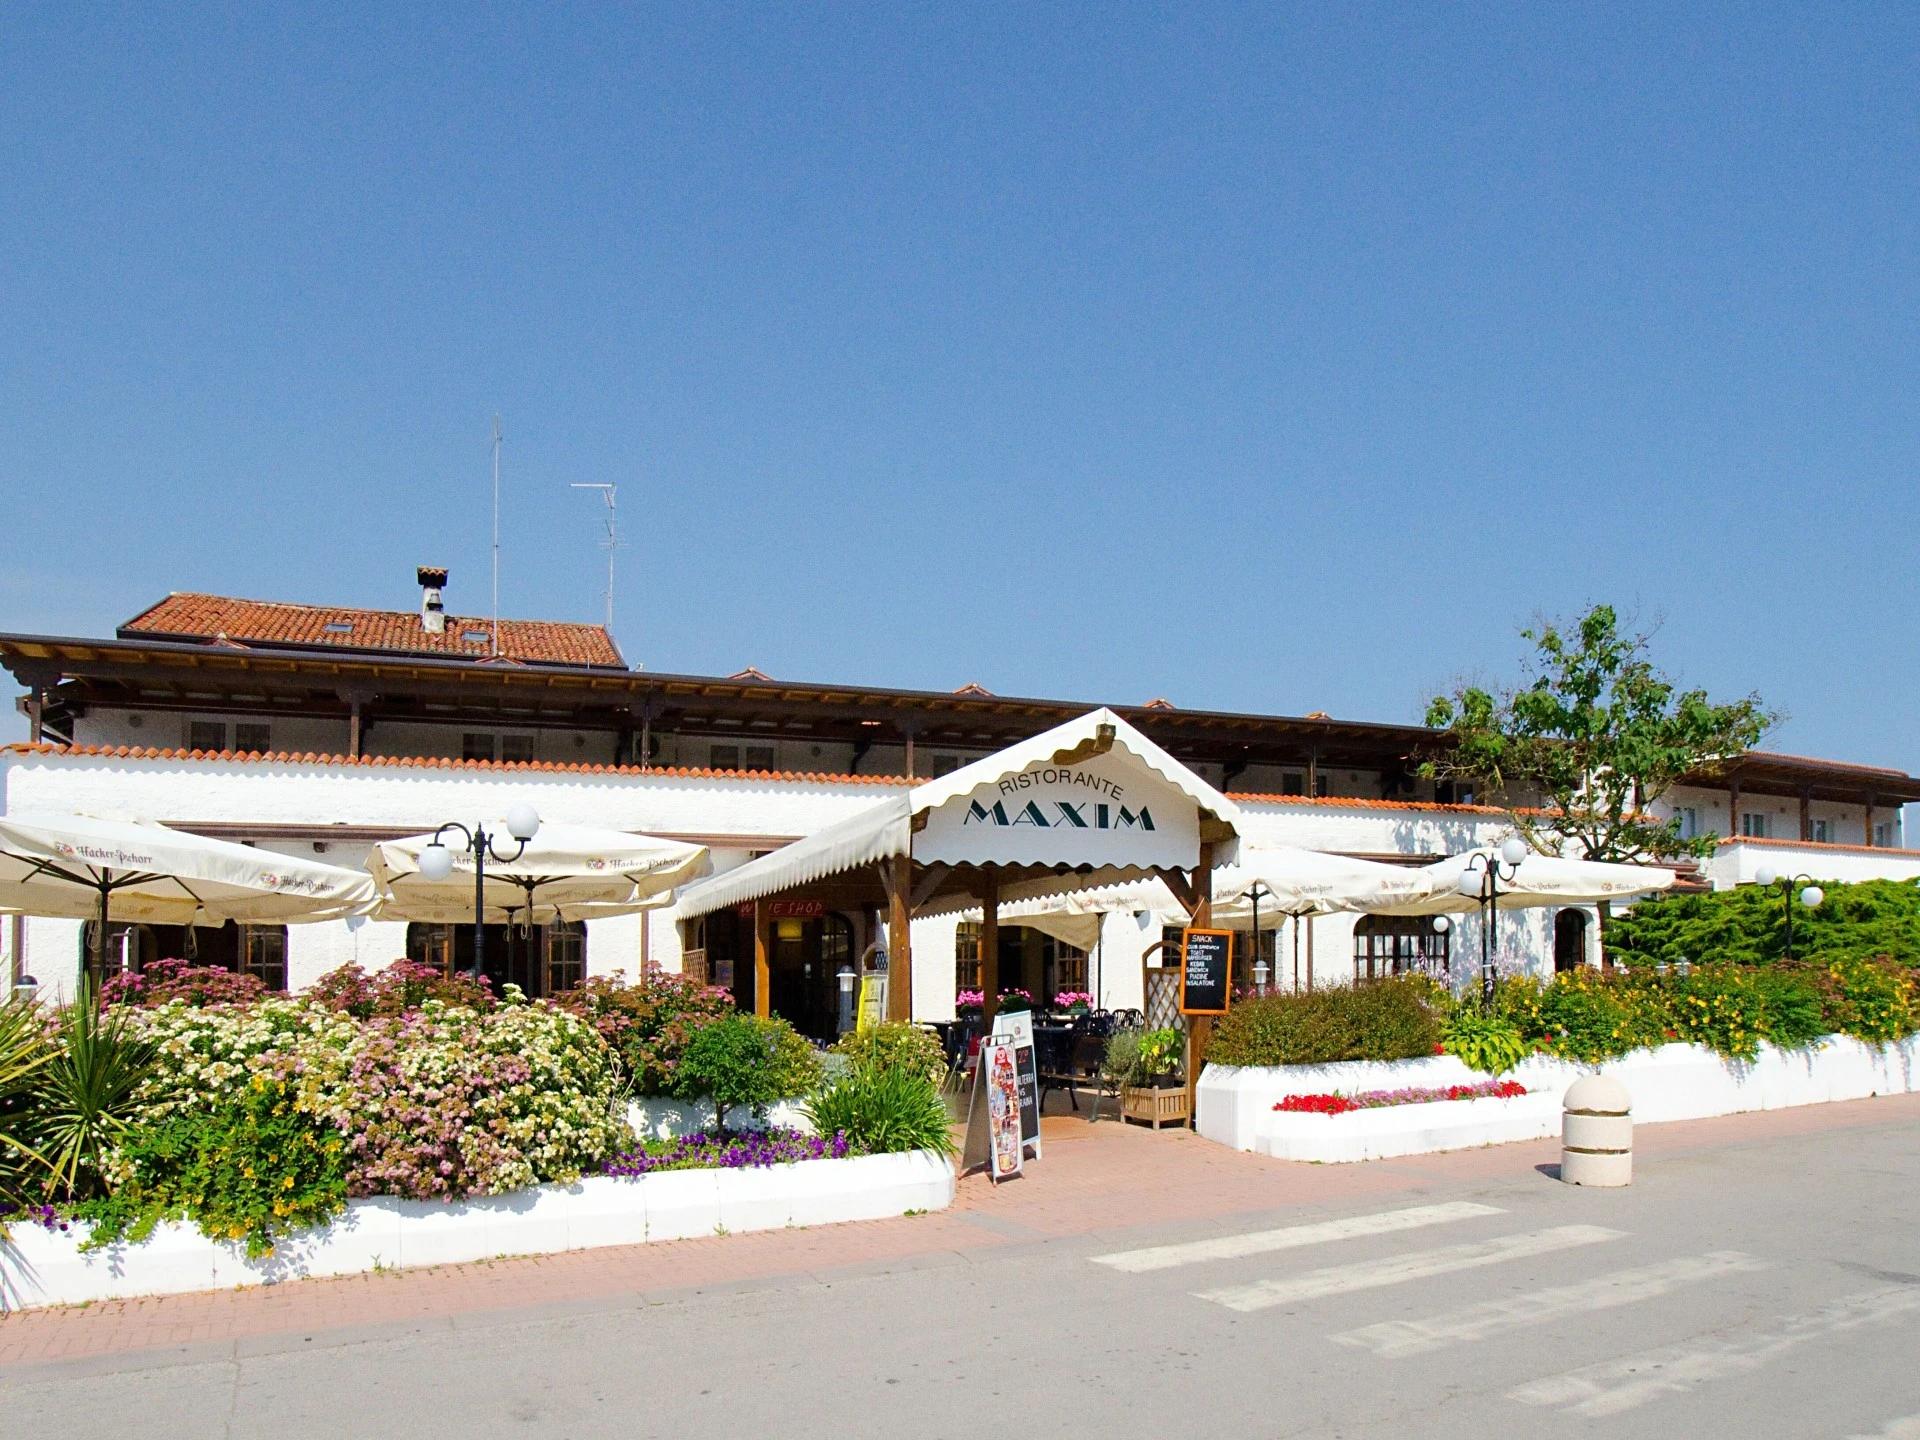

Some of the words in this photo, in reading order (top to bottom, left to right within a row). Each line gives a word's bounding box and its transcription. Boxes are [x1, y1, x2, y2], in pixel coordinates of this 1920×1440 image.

[998, 769, 1124, 801] RISTORANTE
[963, 799, 1155, 831] MAXIM
[76, 846, 153, 864] Hacker-Pschorr
[609, 859, 682, 870] Hacker-Pschorr
[280, 875, 335, 892] Hacker-Pschorr
[741, 903, 782, 914] WE
[788, 902, 823, 915] SHOP
